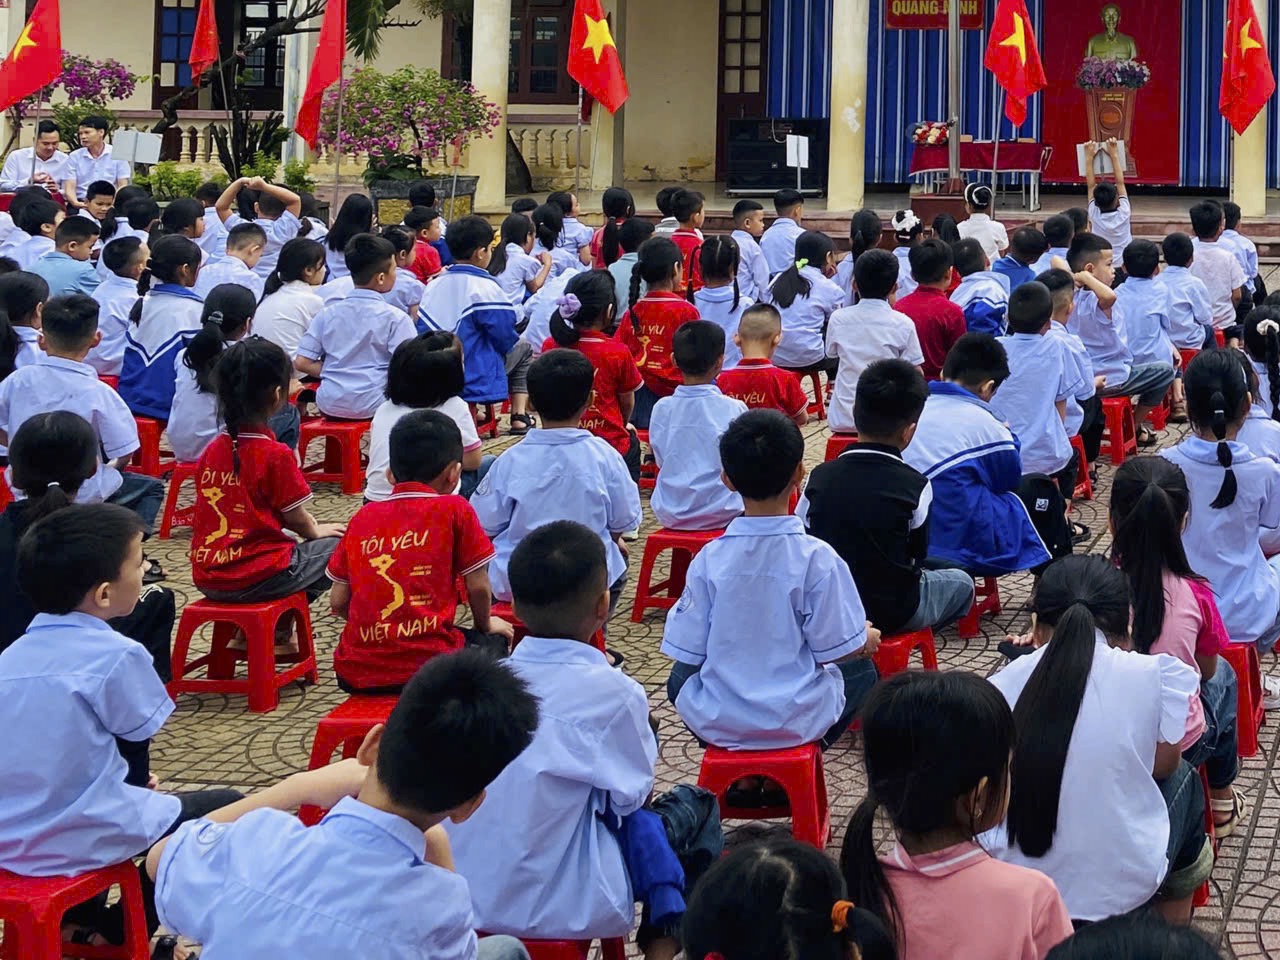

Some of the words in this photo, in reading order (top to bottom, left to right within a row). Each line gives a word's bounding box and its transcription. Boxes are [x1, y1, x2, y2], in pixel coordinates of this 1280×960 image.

[943, 0, 977, 15] NNH
[743, 390, 766, 404] YÊU
[578, 420, 605, 429] NAM
[201, 467, 216, 484] ÔI
[360, 536, 385, 555] TÔI
[391, 529, 429, 551] YÊU
[212, 547, 243, 564] NAM
[360, 622, 391, 644] VIỆT
[397, 616, 437, 638] NAM
